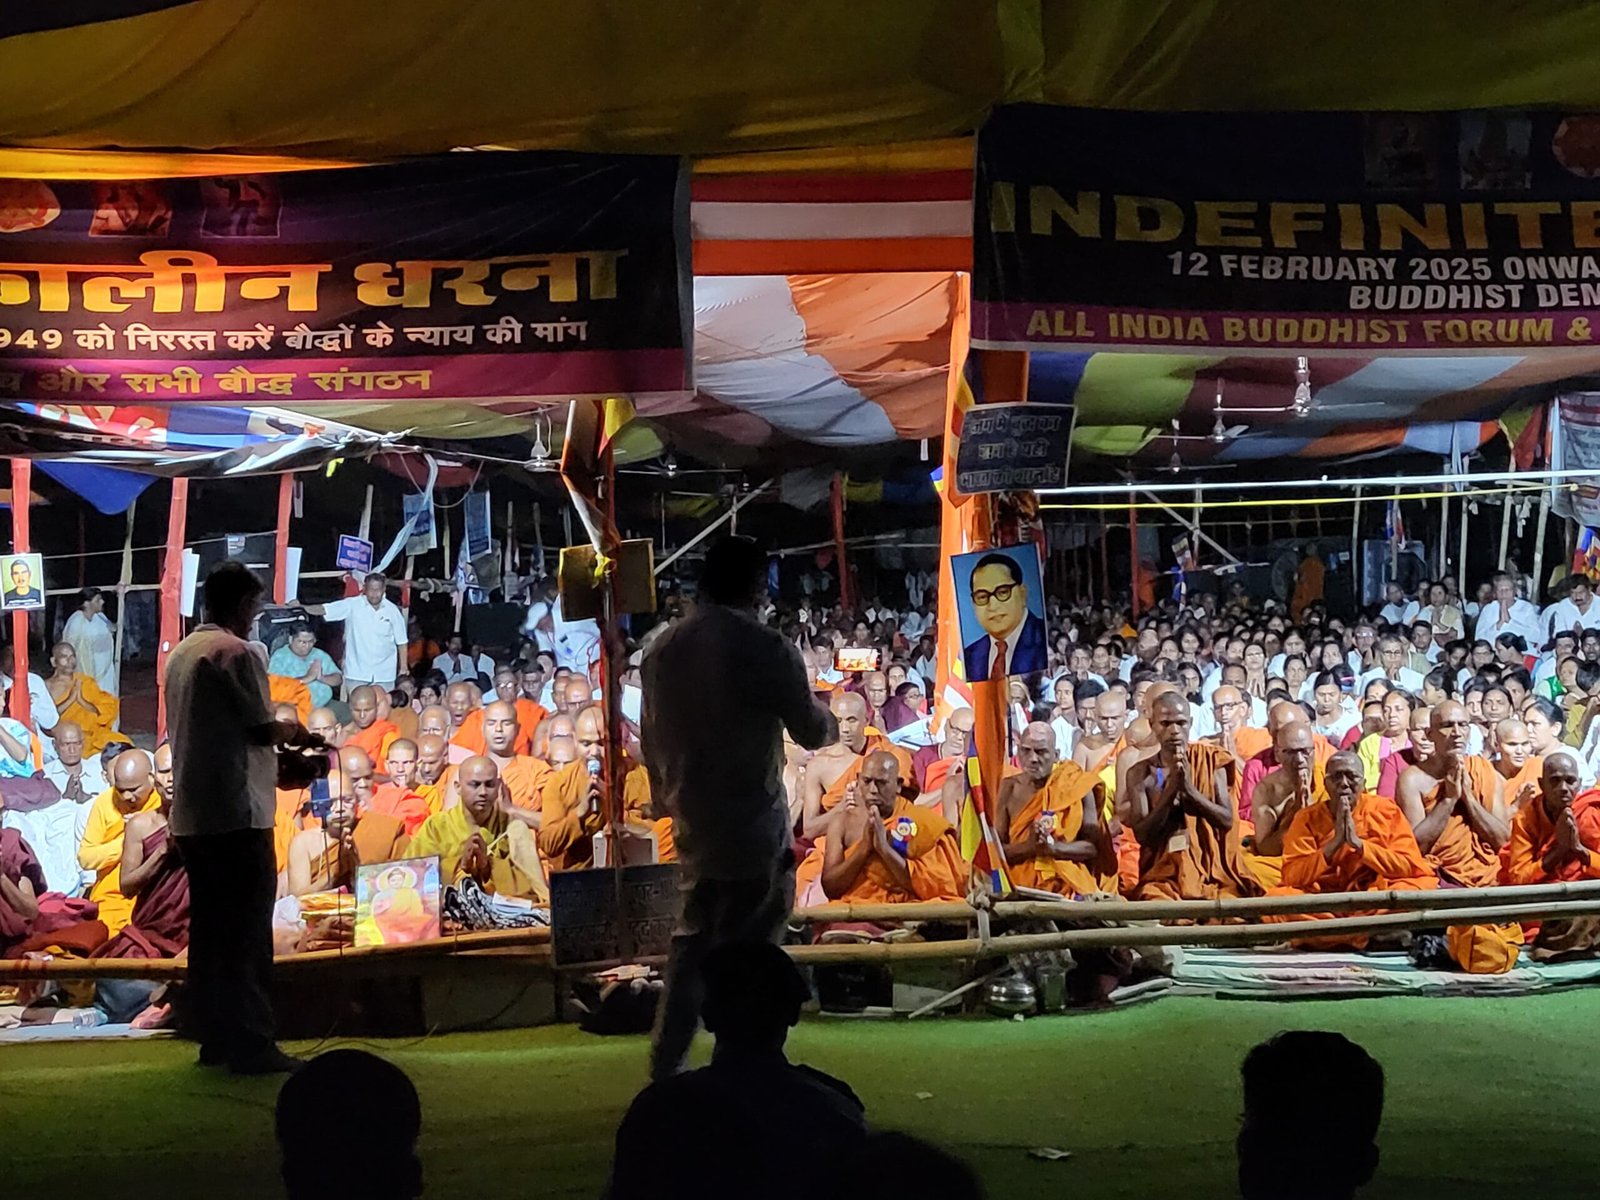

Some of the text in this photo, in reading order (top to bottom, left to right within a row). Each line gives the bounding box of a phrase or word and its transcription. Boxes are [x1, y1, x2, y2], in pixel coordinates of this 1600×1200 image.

[354, 249, 628, 308] धरना
[1168, 251, 1209, 277] 12
[1219, 254, 1397, 281] FEBRUARY
[1408, 257, 1492, 281] 2025
[1349, 284, 1524, 310] BUDDHIST
[73, 323, 116, 351] को
[124, 322, 216, 351] निरस्त
[223, 322, 275, 351] करें
[282, 321, 354, 352] बौद्धों
[362, 321, 395, 349] के
[403, 324, 475, 347] न्याय
[483, 315, 524, 345] की
[531, 316, 589, 343] मांग
[1026, 310, 1593, 344] ALL INDIA BUDDHIST FORUM &
[38, 365, 111, 392] और
[121, 366, 202, 394] सभी
[214, 365, 297, 396] बौद्ध
[309, 366, 433, 392] संगठन
